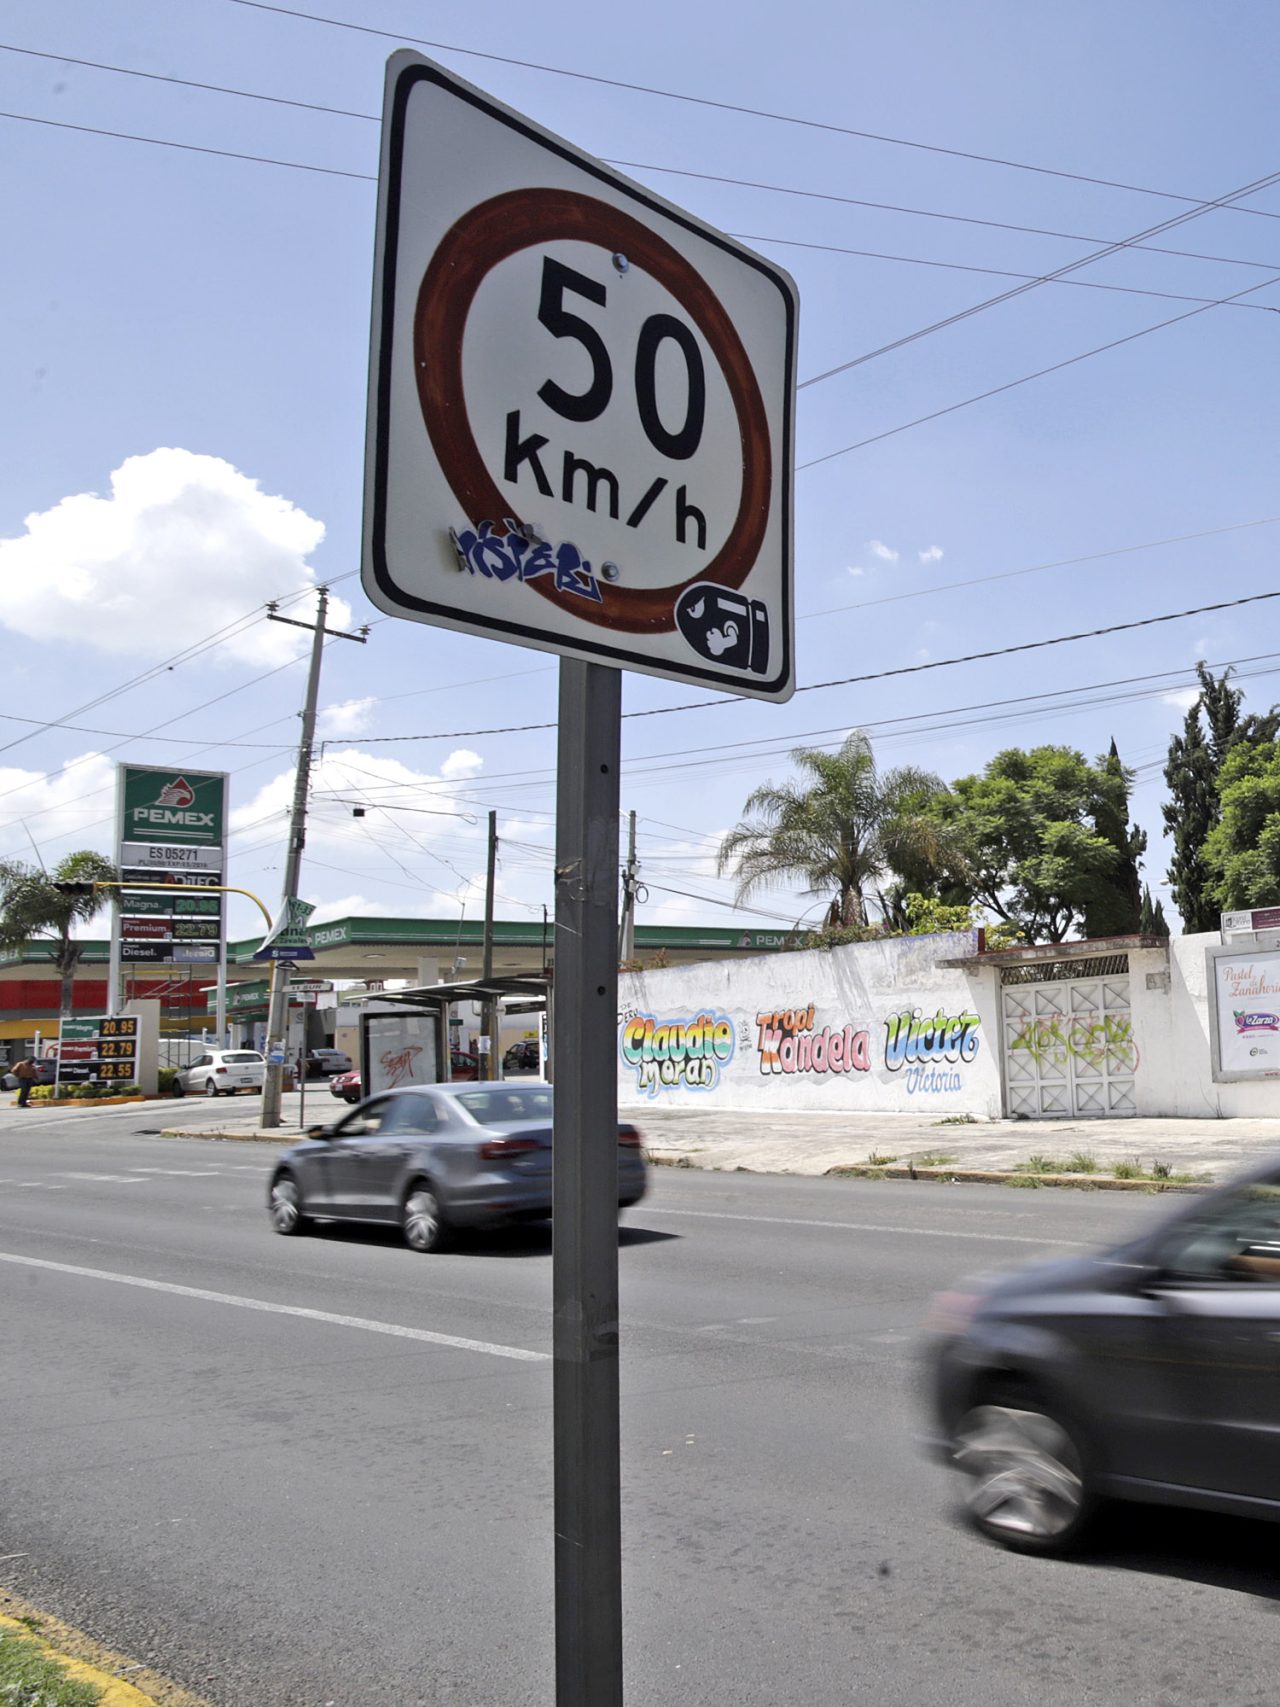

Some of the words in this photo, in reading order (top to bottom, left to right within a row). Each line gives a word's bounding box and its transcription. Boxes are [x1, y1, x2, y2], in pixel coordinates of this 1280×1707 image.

[537, 256, 705, 460] 50
[133, 808, 215, 826] PEMEX
[149, 847, 164, 859] ES
[165, 848, 198, 861] 05271
[314, 927, 347, 945] PEMEX
[756, 935, 803, 946] PEMX
[103, 1021, 134, 1034] 20.95
[622, 1014, 733, 1066] Claudio
[101, 1042, 133, 1056] 22.79
[100, 1064, 132, 1078] 22.55
[905, 1066, 963, 1095] Victoria
